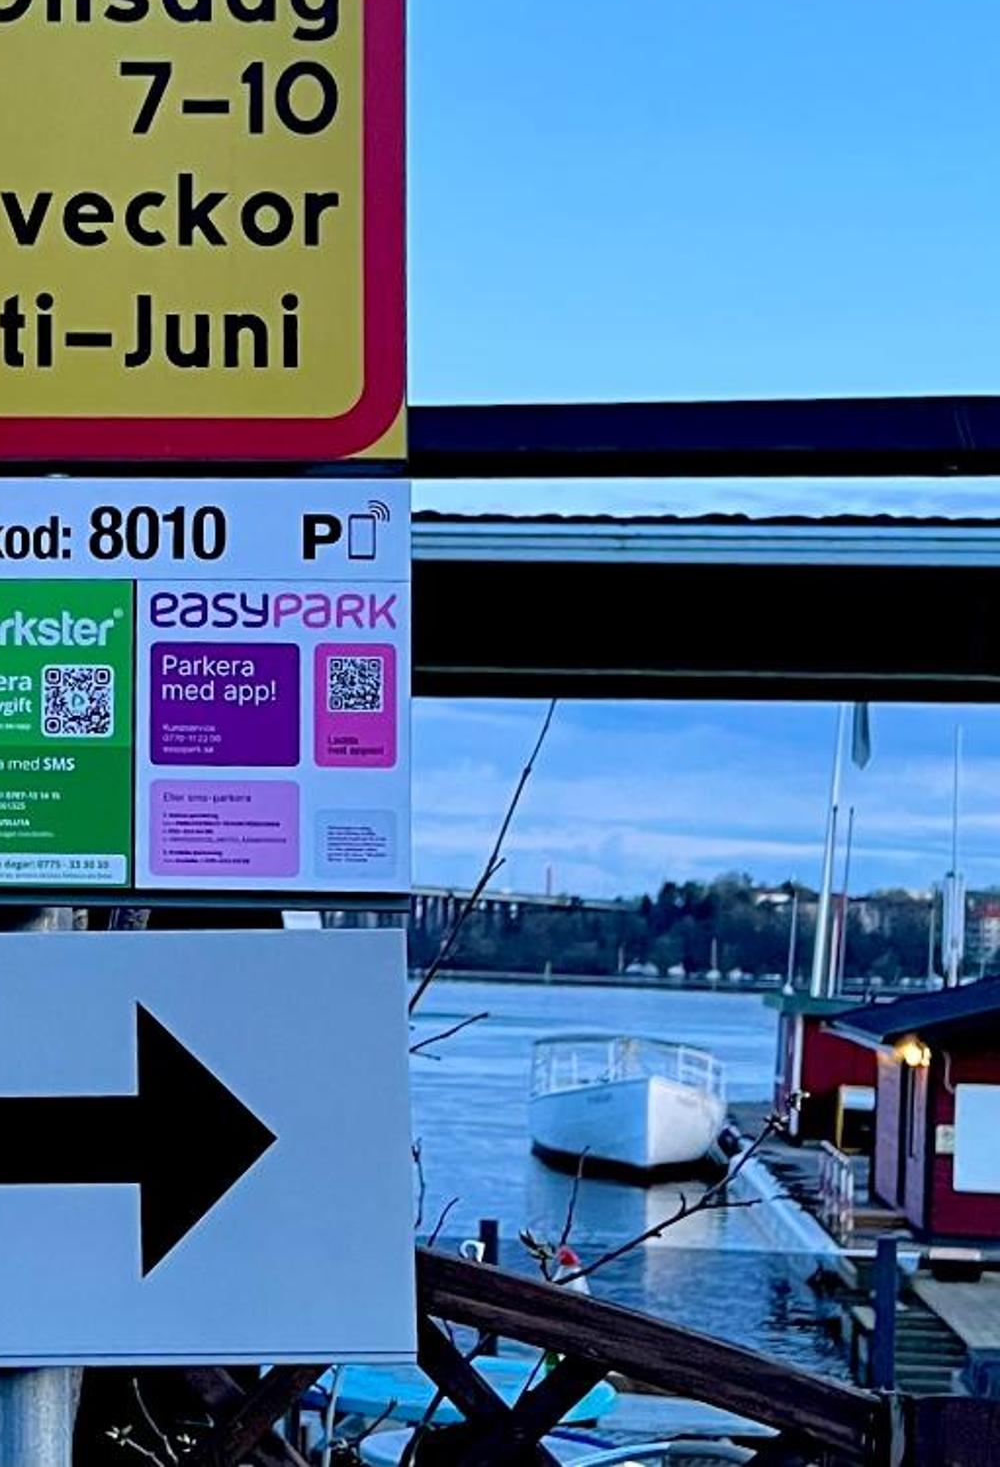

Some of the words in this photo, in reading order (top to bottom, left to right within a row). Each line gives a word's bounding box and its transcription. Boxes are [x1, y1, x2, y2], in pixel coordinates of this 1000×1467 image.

[0, 172, 340, 247] veckor
[88, 505, 227, 560] 8010
[161, 654, 256, 677] Parkera
[161, 680, 215, 701] med
[223, 681, 277, 706] app!
[7, 756, 41, 771] med
[42, 757, 76, 772] SMS
